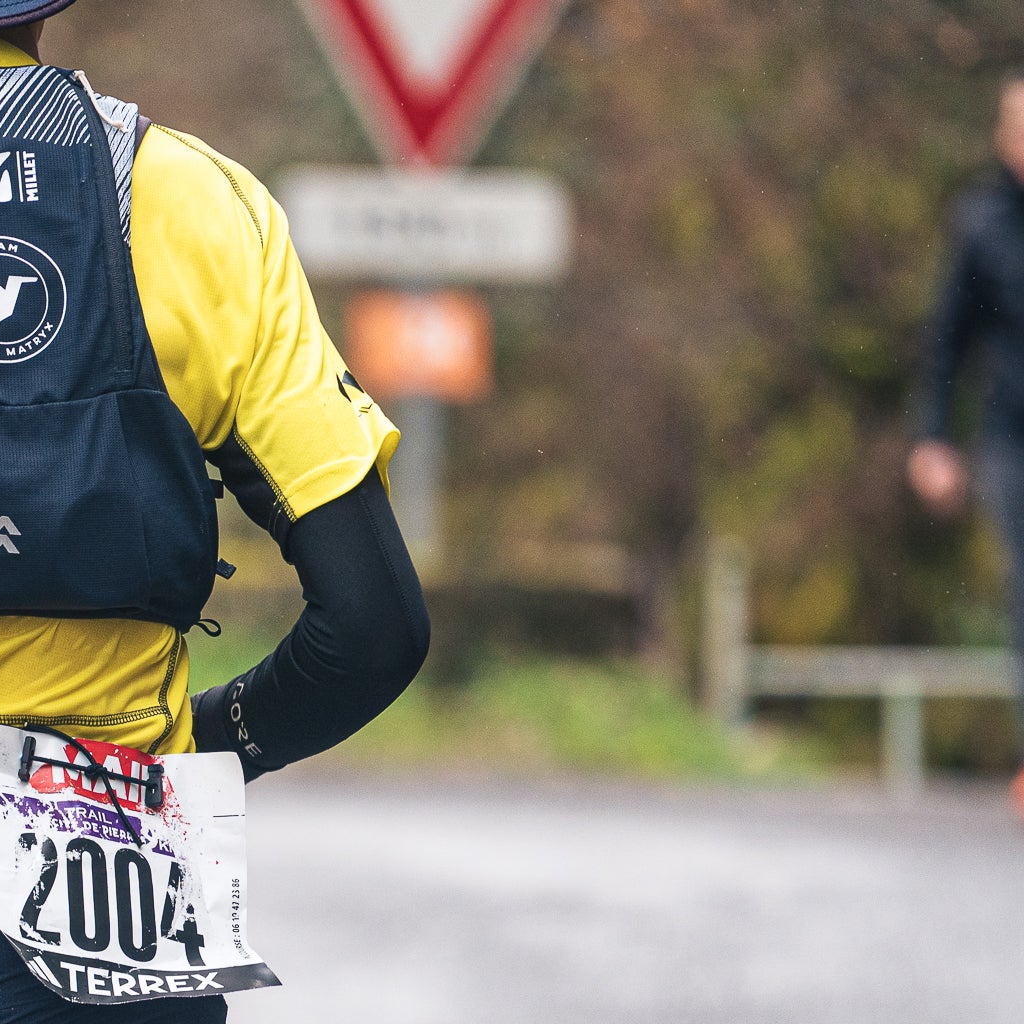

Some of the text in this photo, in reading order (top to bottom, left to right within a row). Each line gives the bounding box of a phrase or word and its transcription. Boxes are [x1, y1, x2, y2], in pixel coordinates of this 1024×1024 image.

[22, 151, 39, 202] MILLET
[6, 322, 53, 356] MATRYX
[64, 807, 112, 824] TRAIL
[231, 878, 240, 888] 86
[231, 889, 240, 899] 23
[17, 832, 207, 966] 2004
[231, 923, 240, 933] 06
[60, 965, 225, 997] TERREX
